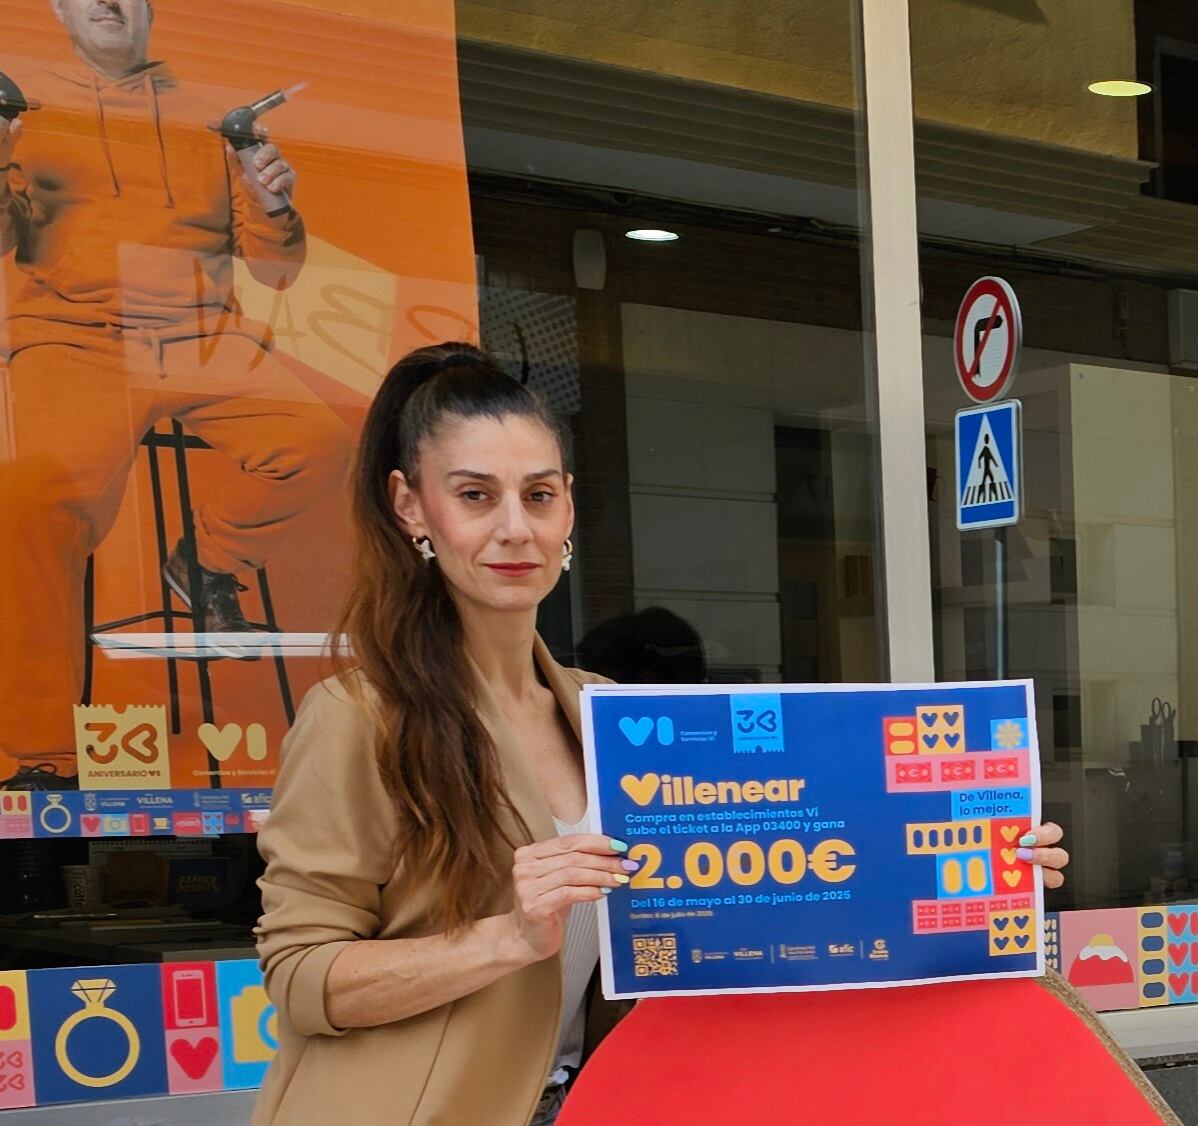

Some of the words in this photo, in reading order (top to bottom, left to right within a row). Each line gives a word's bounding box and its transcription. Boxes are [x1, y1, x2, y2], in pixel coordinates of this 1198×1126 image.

[87, 770, 146, 778] ANIVERSARIO
[620, 773, 805, 806] Villenear
[136, 796, 173, 804] VILLENA
[959, 793, 975, 802] De
[625, 813, 676, 826] Compra
[679, 814, 695, 823] en
[697, 808, 804, 822] establecimientos
[806, 807, 819, 817] Vi
[959, 806, 971, 815] lo
[972, 804, 1013, 816] mejor.
[625, 825, 657, 835] sube
[659, 824, 670, 834] el
[673, 823, 708, 834] ticket
[710, 825, 719, 833] a
[721, 823, 733, 833] la
[735, 822, 760, 835] App
[763, 821, 801, 831] 03400
[803, 822, 812, 833] y
[813, 821, 845, 831] gana
[627, 838, 856, 890] 2.000€
[631, 898, 650, 908] Del
[667, 896, 684, 907] de
[686, 897, 721, 909] mayo
[723, 894, 736, 905] al
[737, 894, 753, 904] 30
[755, 893, 771, 904] de
[772, 892, 803, 906] junio
[805, 891, 821, 902] de
[822, 890, 851, 901] 2025
